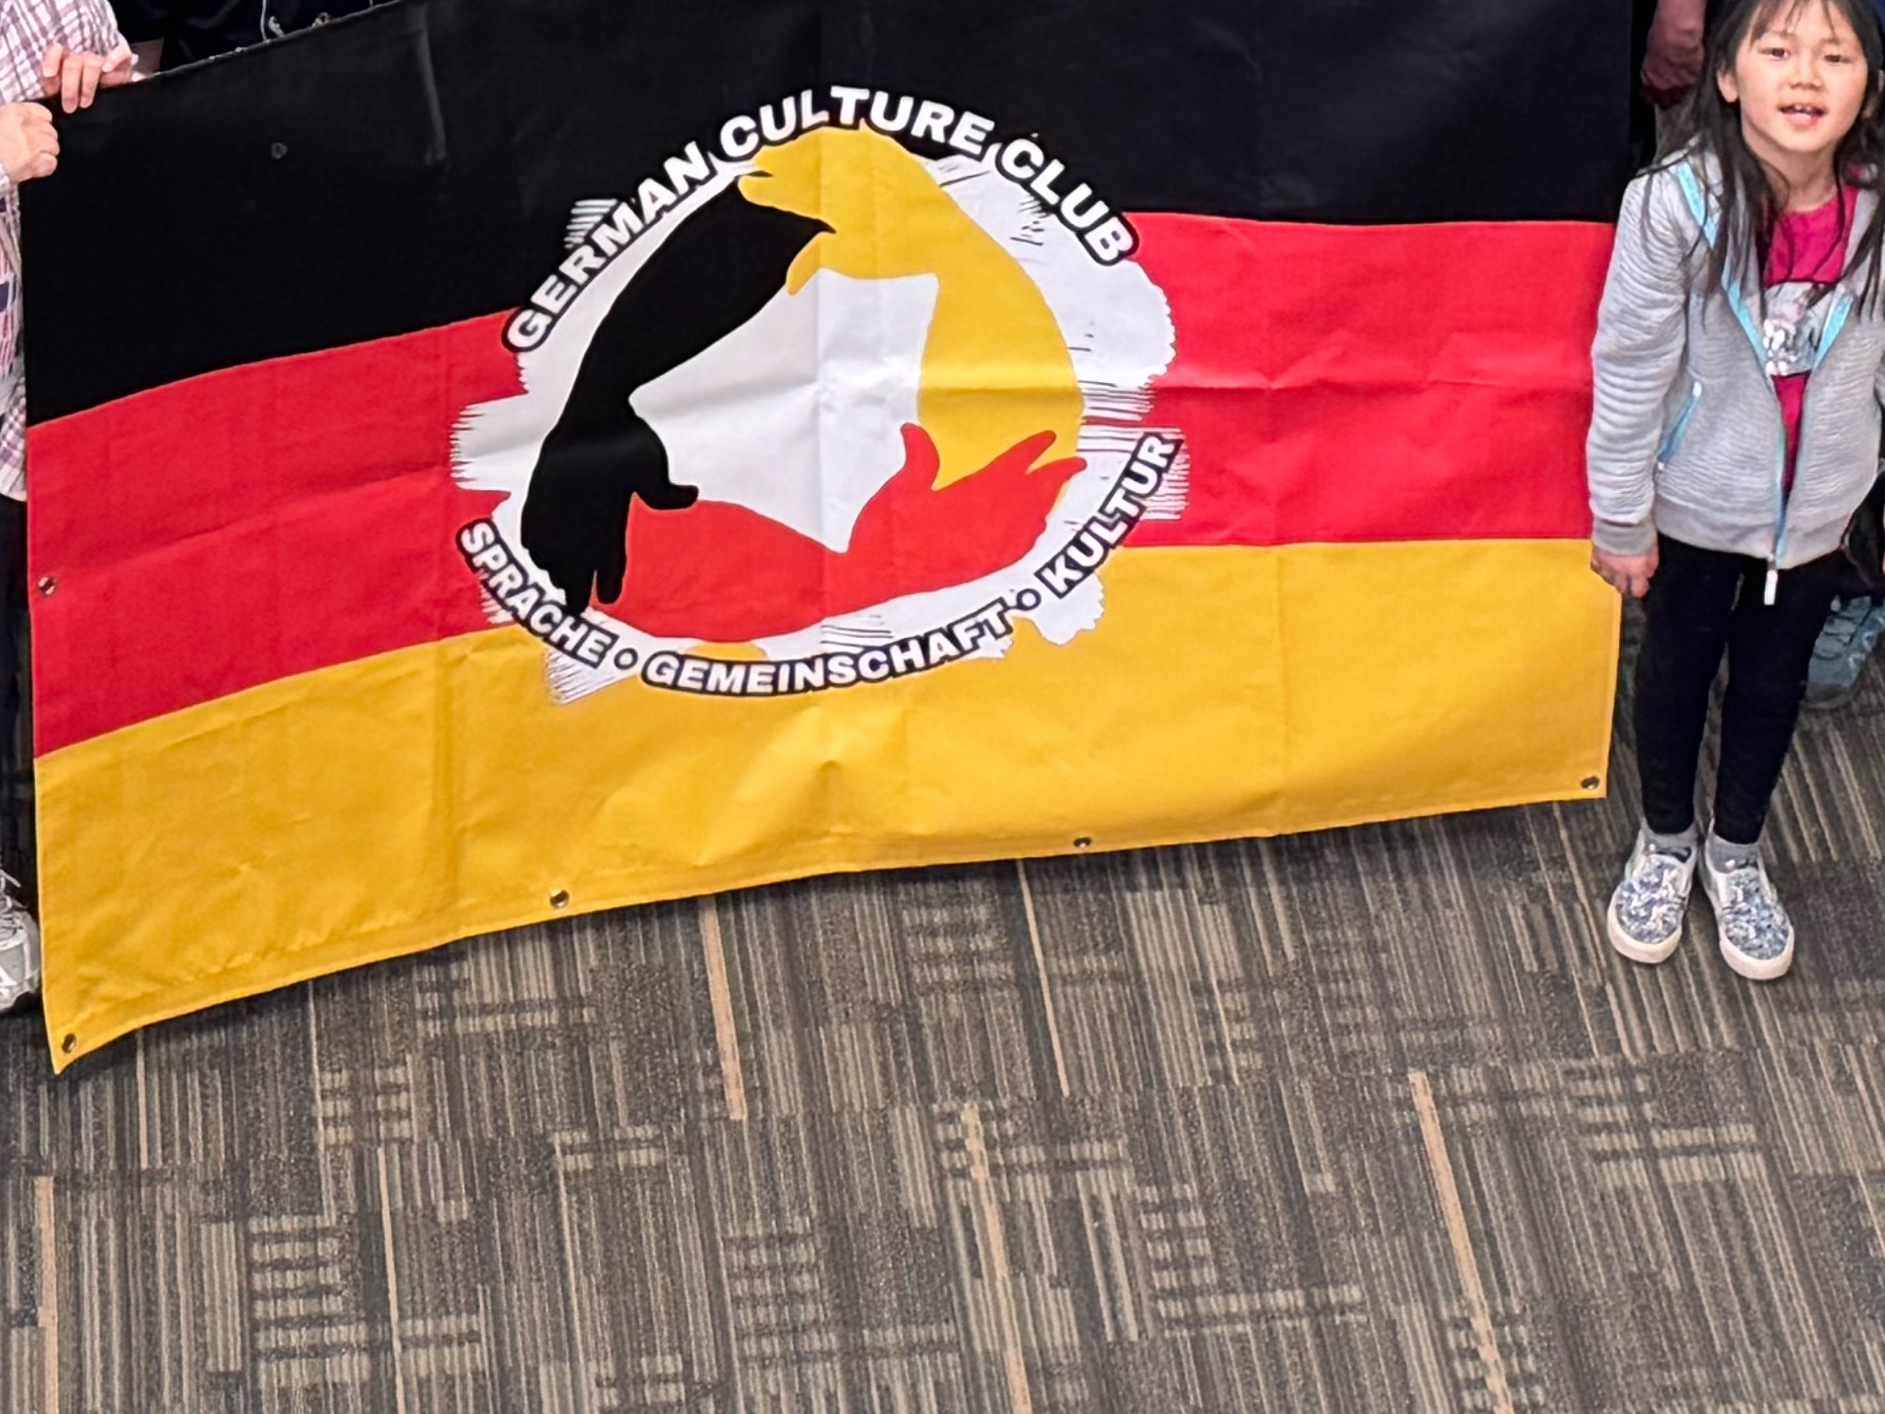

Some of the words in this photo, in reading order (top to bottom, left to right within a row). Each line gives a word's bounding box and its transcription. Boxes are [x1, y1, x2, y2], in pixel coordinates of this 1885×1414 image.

[506, 139, 711, 350] GERMAN
[718, 84, 996, 160] CULTURE
[999, 137, 1136, 264] CLUB
[459, 521, 613, 666] SPRACHE
[644, 600, 1013, 694] GEMEINSCHAFT
[1040, 433, 1179, 596] KULTUR
